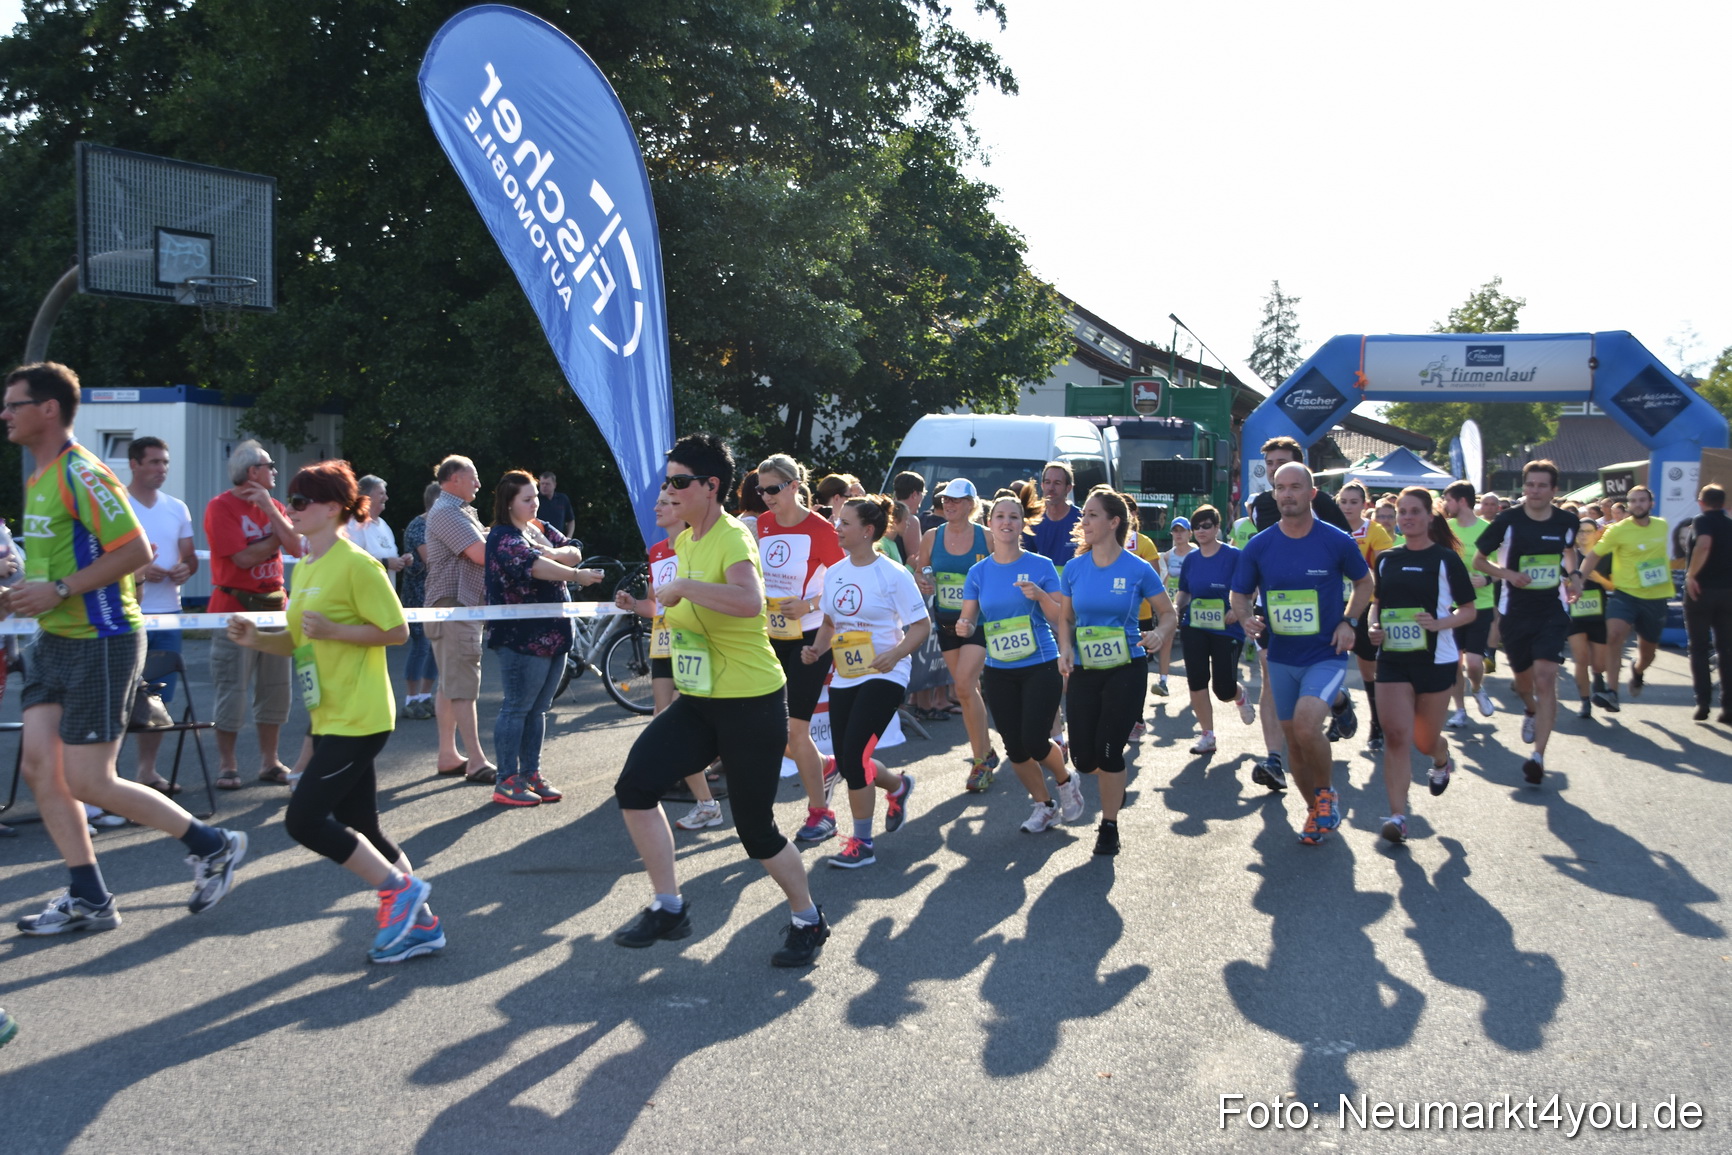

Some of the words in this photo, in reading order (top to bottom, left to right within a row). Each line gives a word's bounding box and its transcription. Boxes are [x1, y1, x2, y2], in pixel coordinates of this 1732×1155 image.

[1451, 367, 1538, 383] firmenlauf
[1293, 396, 1337, 406] Fischer
[71, 461, 122, 519] BOCK
[1605, 479, 1627, 493] RW
[1524, 568, 1556, 580] 1074
[1644, 569, 1662, 580] 641
[940, 587, 964, 600] 128
[1574, 600, 1598, 610] 1300
[770, 614, 787, 628] 83
[1194, 610, 1222, 622] 1496
[1273, 608, 1314, 623] 1495
[658, 631, 671, 646] 85
[1385, 625, 1421, 640] 1088
[992, 633, 1031, 651] 1285
[1083, 641, 1122, 658] 1281
[677, 654, 702, 676] 677
[844, 649, 863, 666] 84
